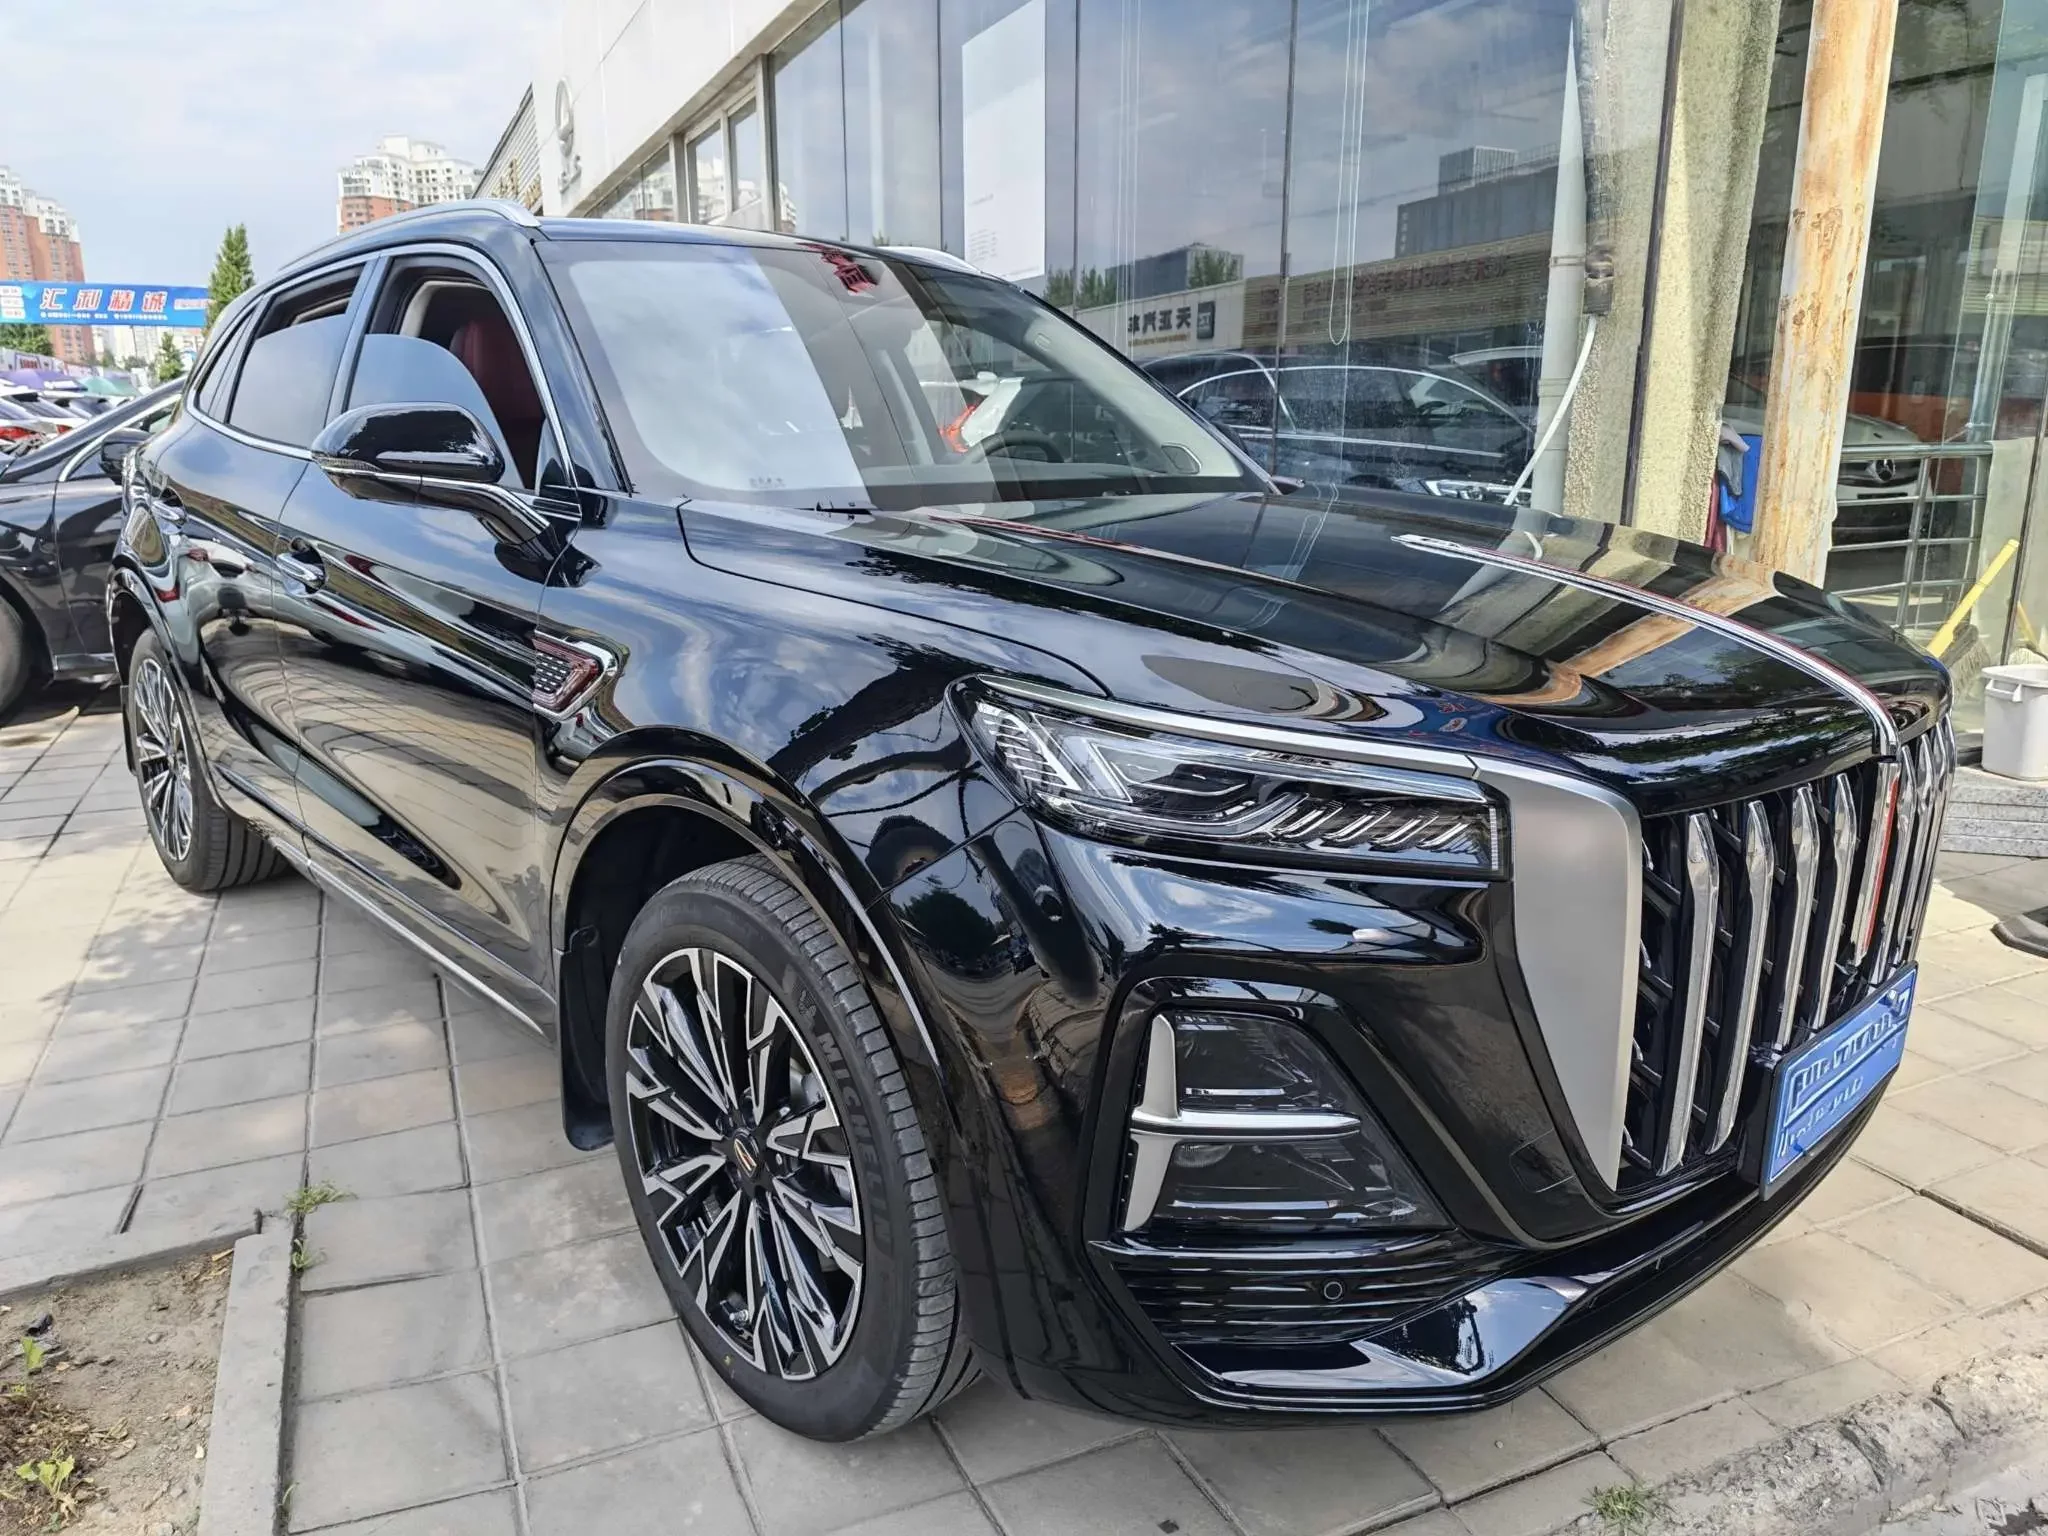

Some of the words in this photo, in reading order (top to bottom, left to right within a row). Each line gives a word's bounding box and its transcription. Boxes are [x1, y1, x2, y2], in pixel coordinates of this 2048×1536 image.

[40, 288, 168, 312] 汇利精诚
[816, 1031, 895, 1256] MICHELIN
